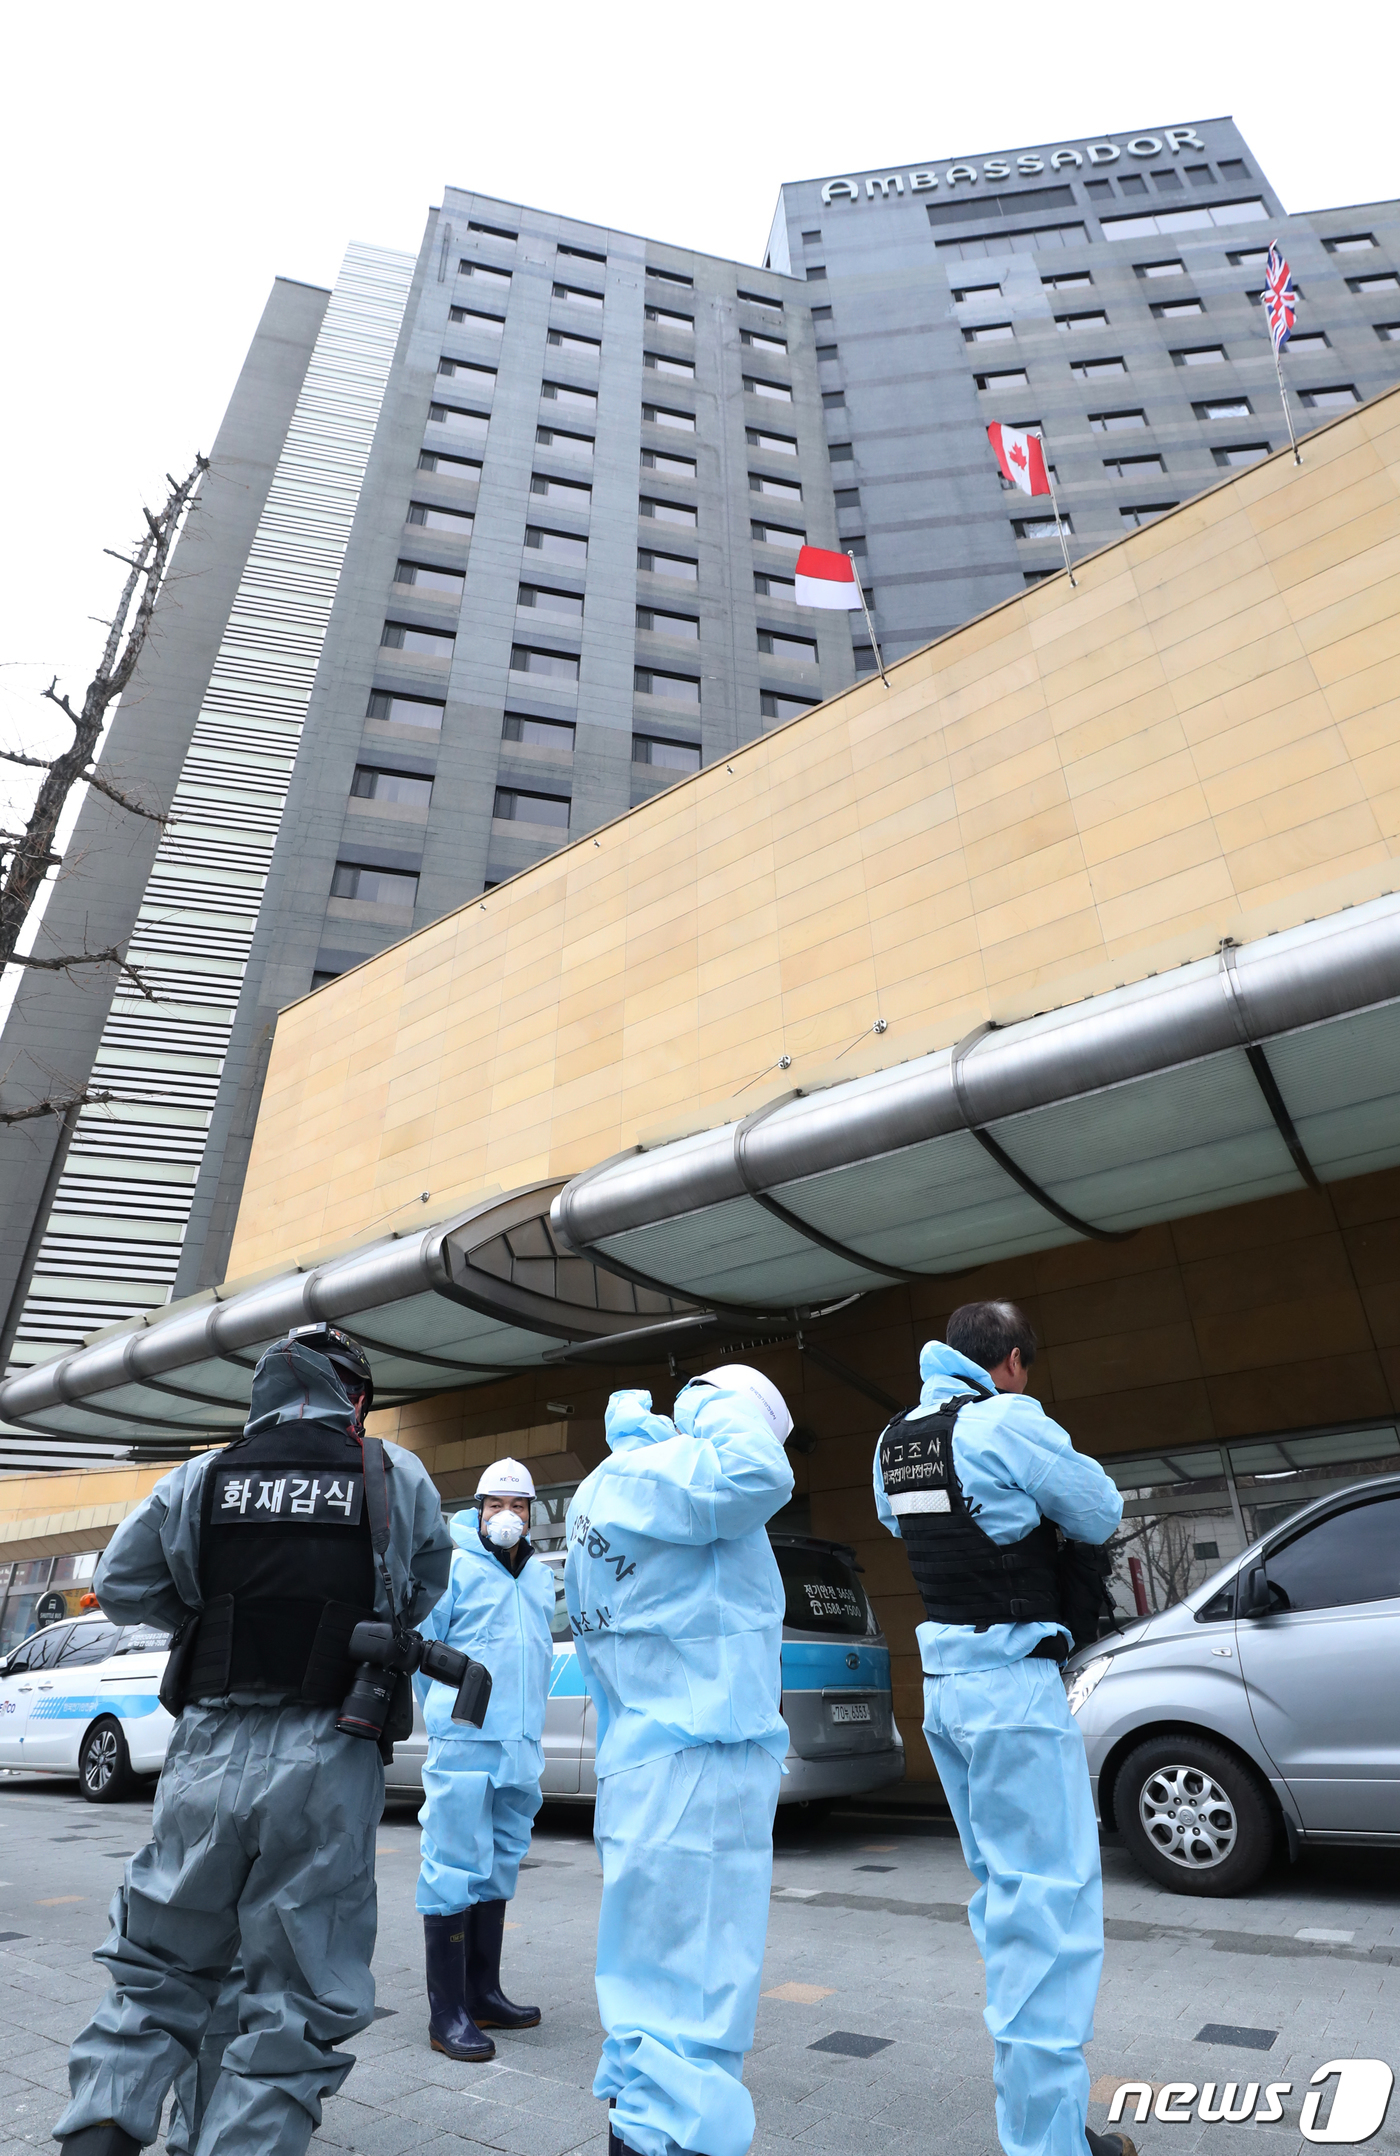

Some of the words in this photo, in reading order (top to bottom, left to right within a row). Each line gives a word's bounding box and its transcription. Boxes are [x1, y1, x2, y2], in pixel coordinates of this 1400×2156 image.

[820, 128, 1205, 205] AMBASSADOR
[881, 1437, 941, 1465] 사고조사
[883, 1461, 944, 1485] 한국전기안전공사
[220, 1478, 355, 1517] 화재감식
[803, 1584, 837, 1600] 전기안전
[823, 1602, 862, 1617] 1588-7500
